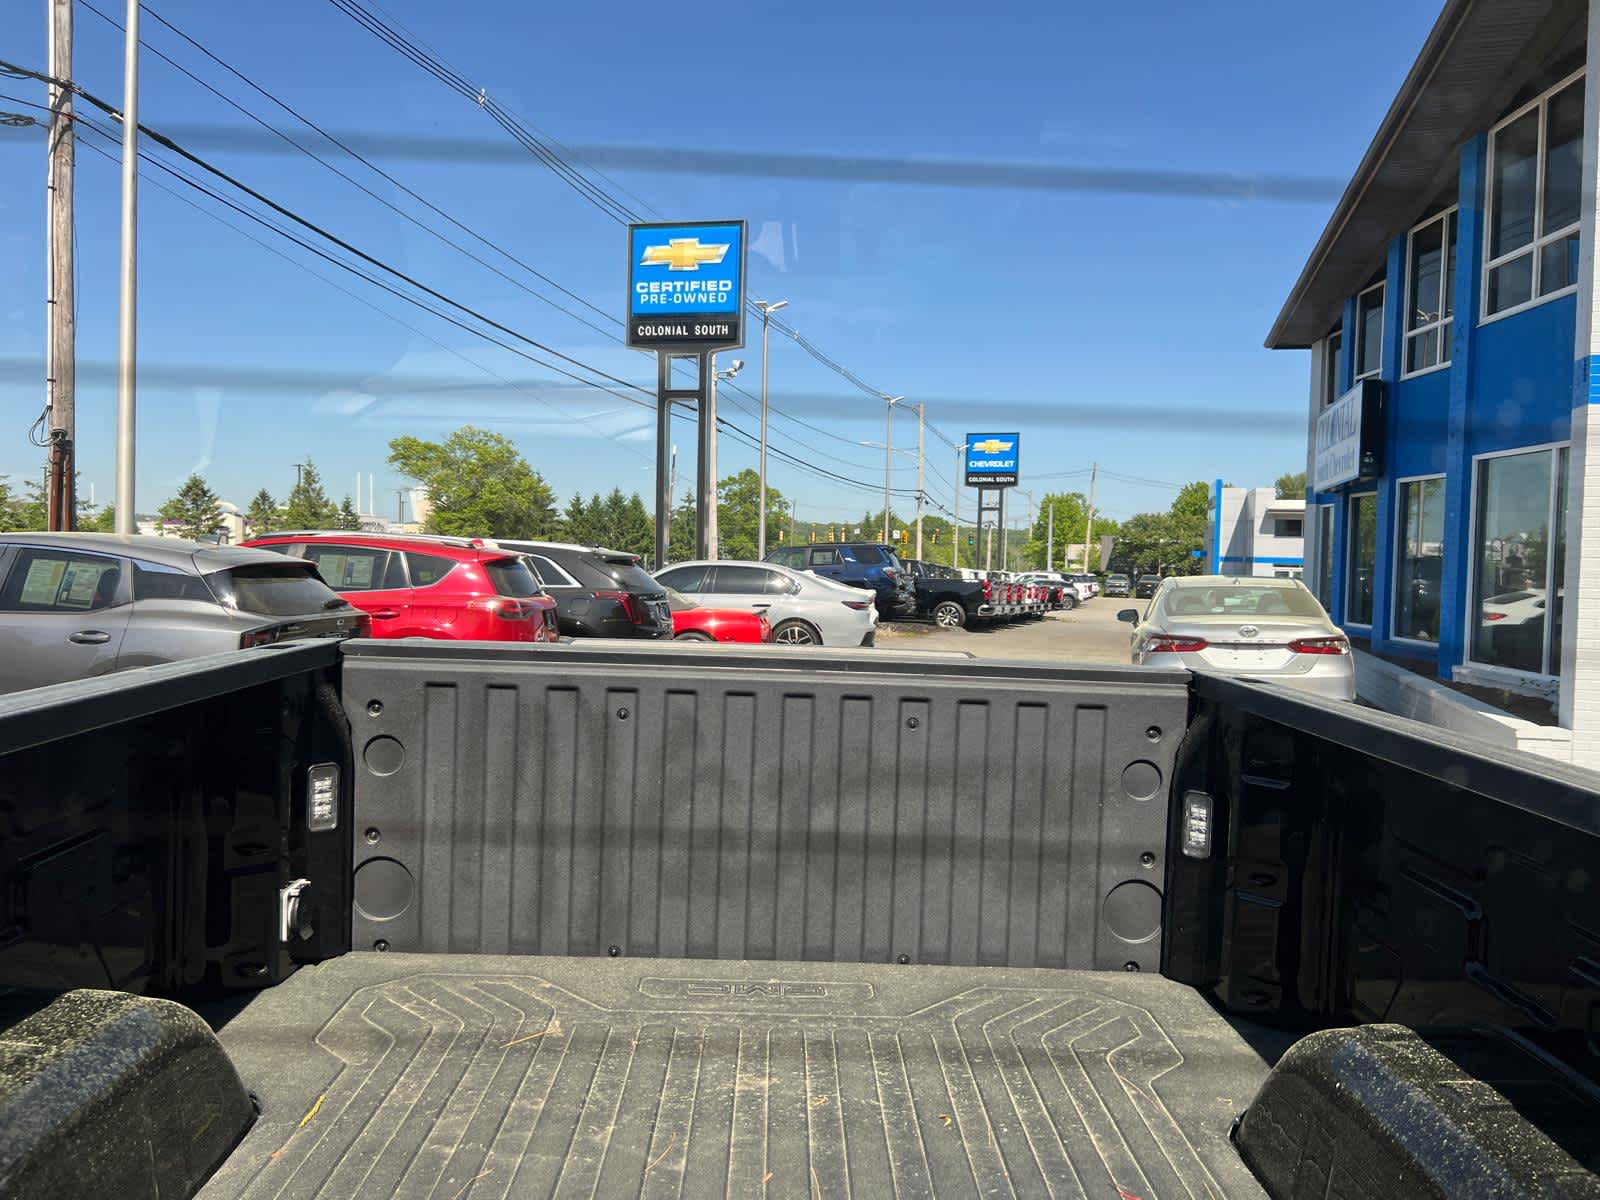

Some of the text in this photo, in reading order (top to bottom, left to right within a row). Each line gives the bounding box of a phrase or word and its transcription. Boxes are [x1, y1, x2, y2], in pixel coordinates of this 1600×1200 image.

[636, 280, 732, 293] CERTIFIED
[640, 292, 727, 304] PRE-OWNED
[637, 324, 729, 337] COLONIAL SOUTH
[969, 460, 1015, 468] CHEVROLET
